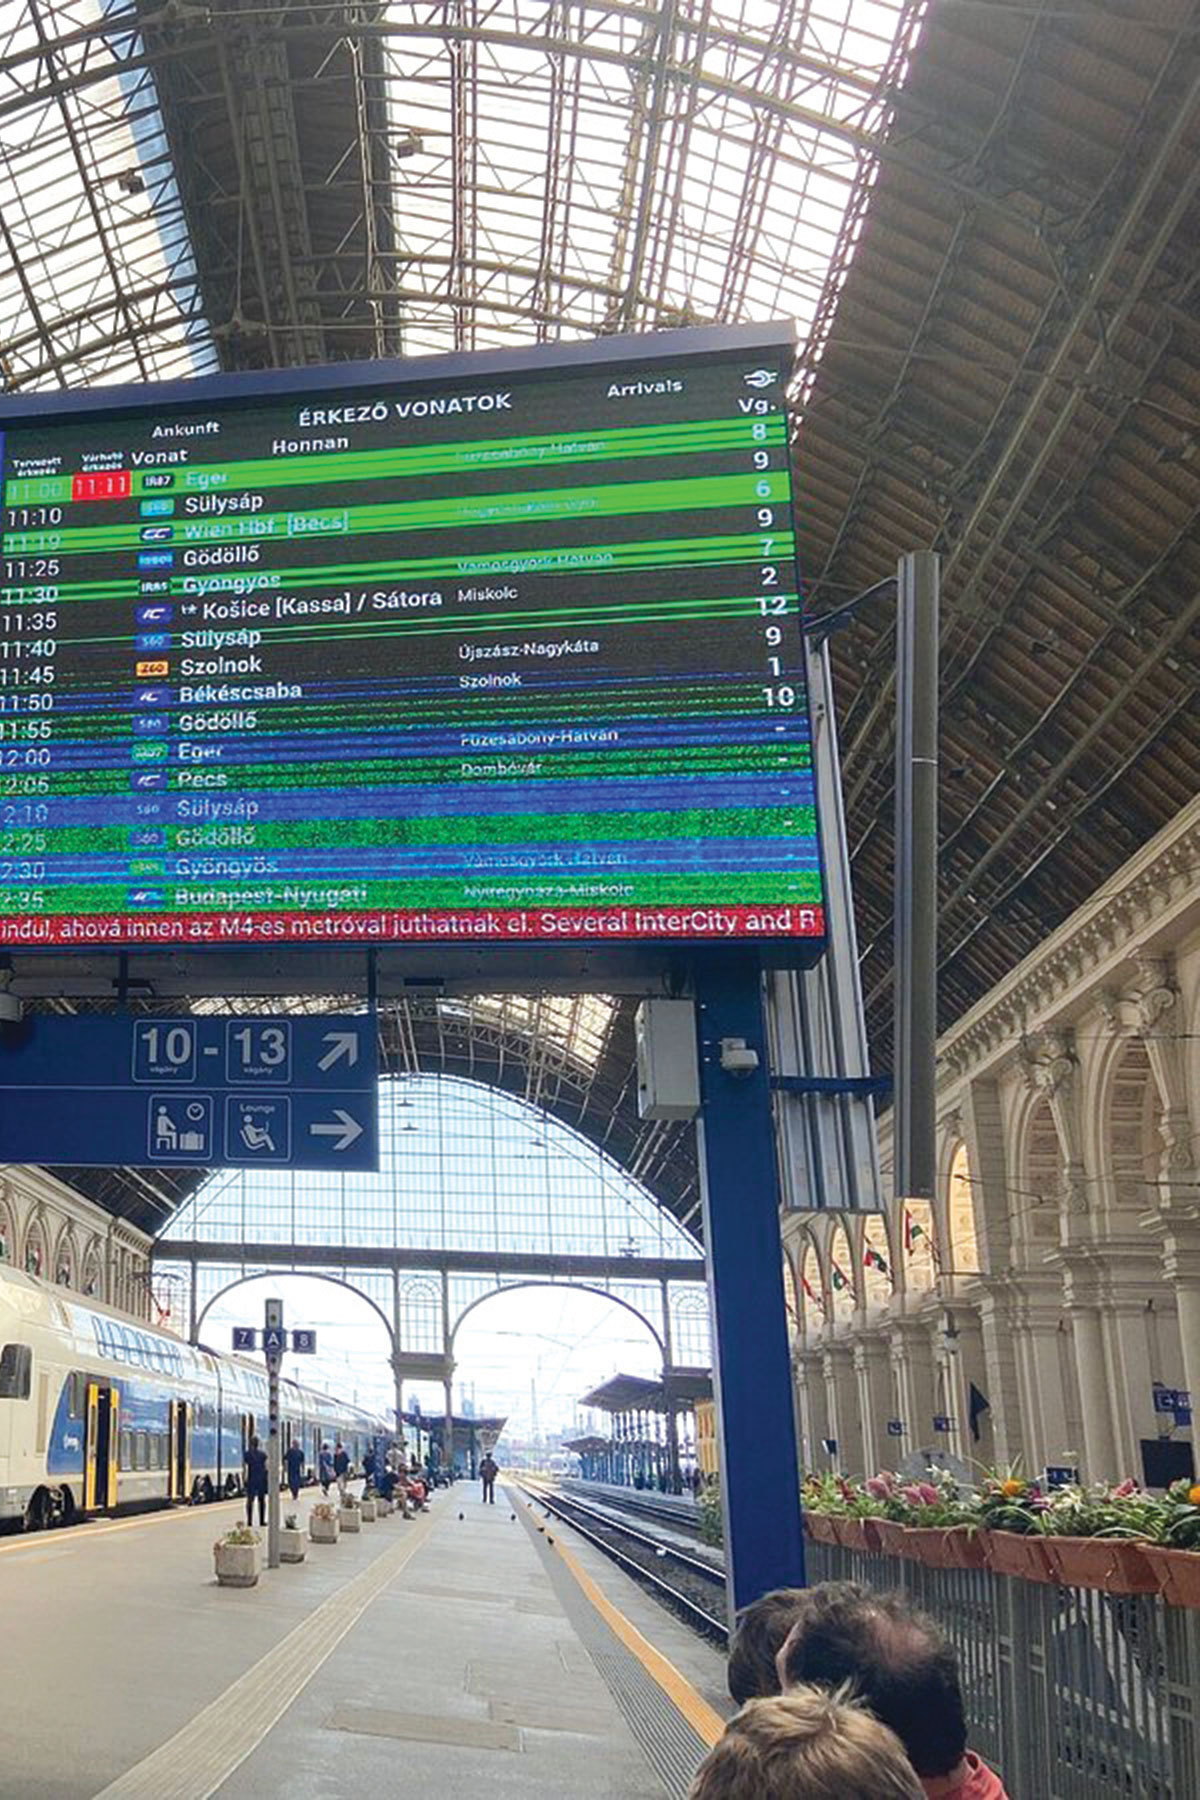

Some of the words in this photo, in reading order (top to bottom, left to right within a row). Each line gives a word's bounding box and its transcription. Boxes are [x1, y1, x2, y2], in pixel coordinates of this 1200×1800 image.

[607, 379, 683, 398] Arrivals
[300, 401, 389, 428] ÉRKEZŐ
[395, 393, 512, 419] VONATOK
[738, 398, 776, 415] Vg.
[152, 422, 220, 438] Ankunft
[272, 435, 349, 454] Honnan
[752, 423, 767, 441] 8
[131, 449, 188, 466] Vonat
[8, 507, 62, 526] 11:10
[185, 493, 264, 514] Sülysáp
[753, 450, 769, 470] 9
[185, 523, 233, 538] Wien
[239, 519, 275, 535] Hbf
[755, 480, 772, 497] 6
[6, 560, 60, 579] 11:25
[183, 545, 260, 567] Gödöllő
[757, 508, 773, 527] 9
[2, 586, 58, 606] 11:30
[760, 539, 774, 556] 7
[3, 611, 57, 632] 11:35
[203, 599, 270, 619] Košice
[276, 592, 351, 618] [Kassa]
[356, 593, 367, 611] /
[372, 590, 443, 610] Sátora
[458, 586, 519, 602] Miskolc
[761, 566, 778, 585] 2
[1, 638, 56, 658] 11:40
[755, 596, 788, 616] 12
[0, 666, 55, 686] 11:45
[180, 655, 263, 676] Szolnok
[458, 639, 600, 662] Újszász-Nagykáta
[765, 626, 782, 646] 9
[179, 681, 303, 703] Békéscsaba
[459, 672, 522, 689] Szolnok
[768, 656, 780, 677] 1
[179, 711, 257, 732] Gödöllő
[762, 686, 794, 707] 10
[178, 741, 225, 763] Eger
[176, 798, 260, 821] Sülysáp
[2, 918, 54, 941] indul,
[60, 917, 122, 938] ahová
[127, 917, 184, 937] innen
[189, 921, 212, 936] az
[220, 917, 285, 936] M4-es
[291, 915, 386, 936] metróval
[392, 913, 501, 938] juthatnak
[507, 914, 533, 933] el.
[541, 912, 627, 932] Several
[635, 910, 737, 932] InterCity
[745, 908, 791, 930] and
[141, 1028, 192, 1064] 10
[234, 1028, 286, 1065] 13
[240, 1331, 248, 1343] 7
[267, 1331, 280, 1345] A
[299, 1333, 309, 1347] 8
